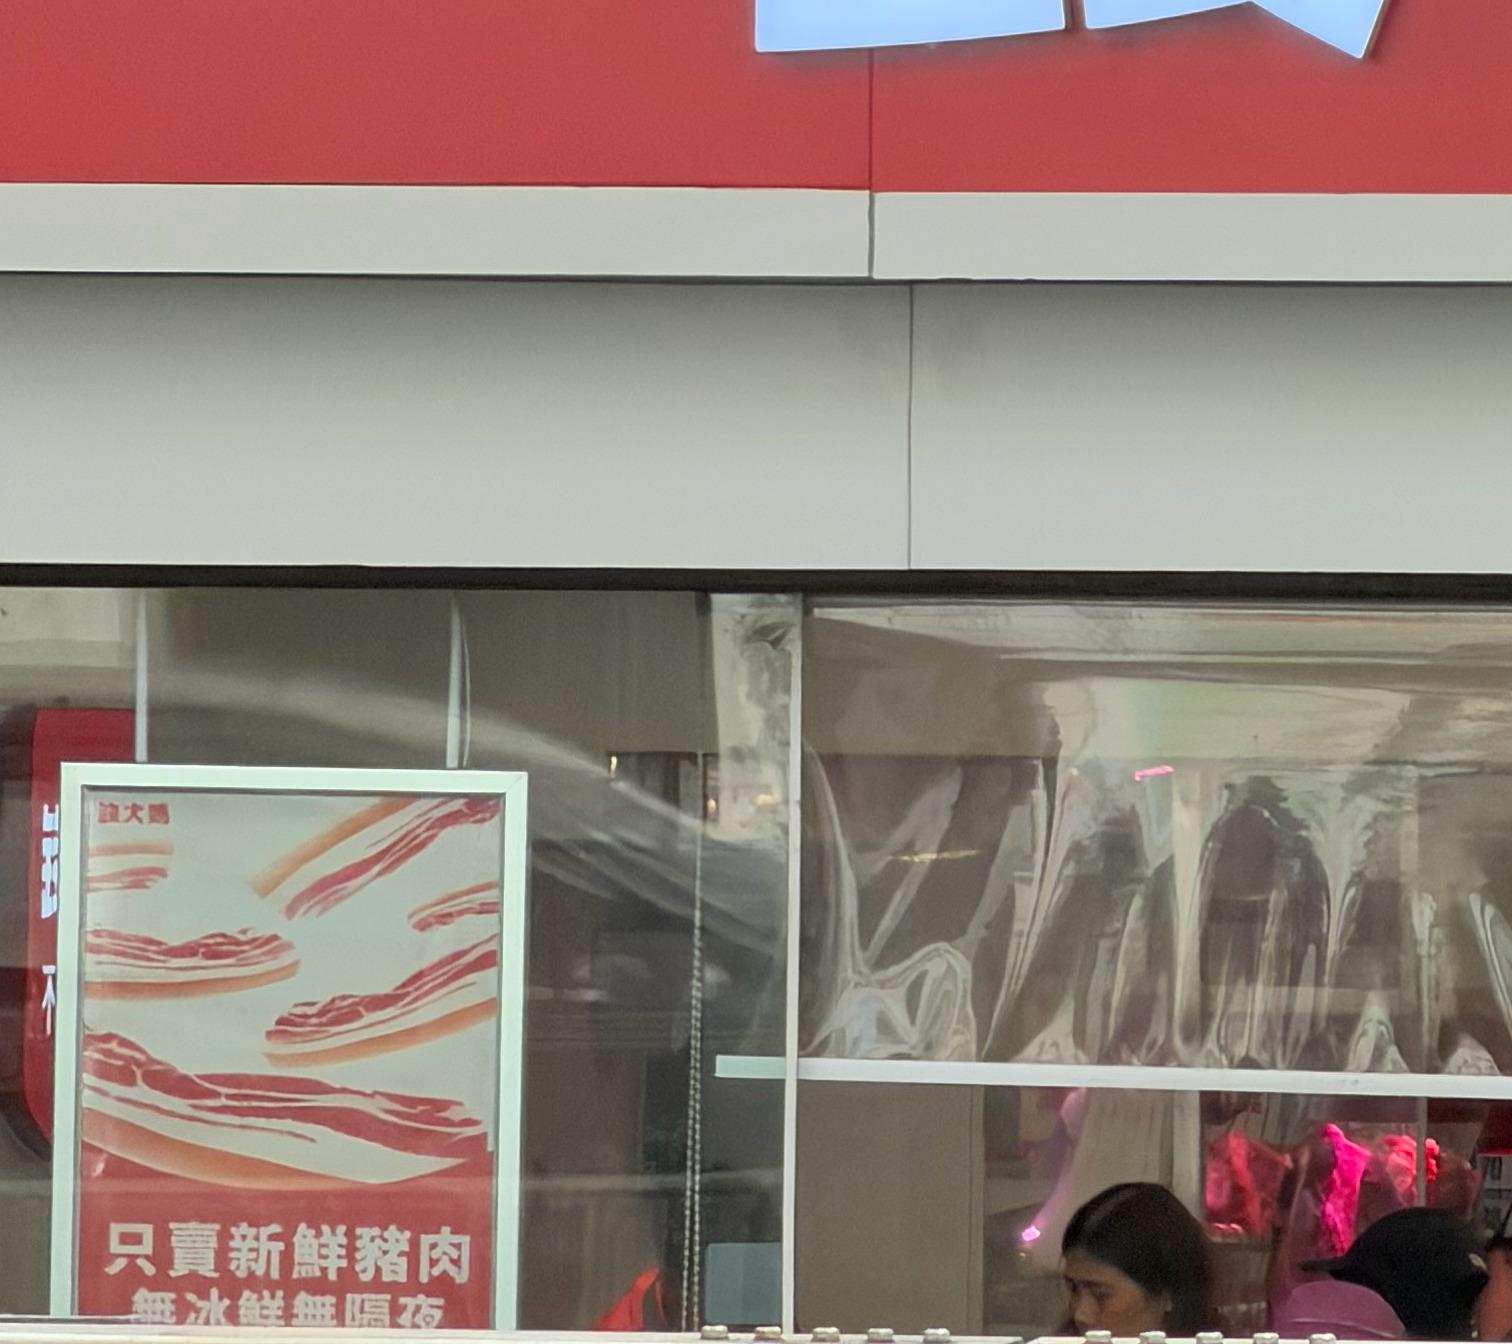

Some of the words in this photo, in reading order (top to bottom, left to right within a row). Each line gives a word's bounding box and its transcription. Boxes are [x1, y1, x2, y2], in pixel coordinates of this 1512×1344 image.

[105, 1221, 472, 1285] 只賣新鮮豬肉
